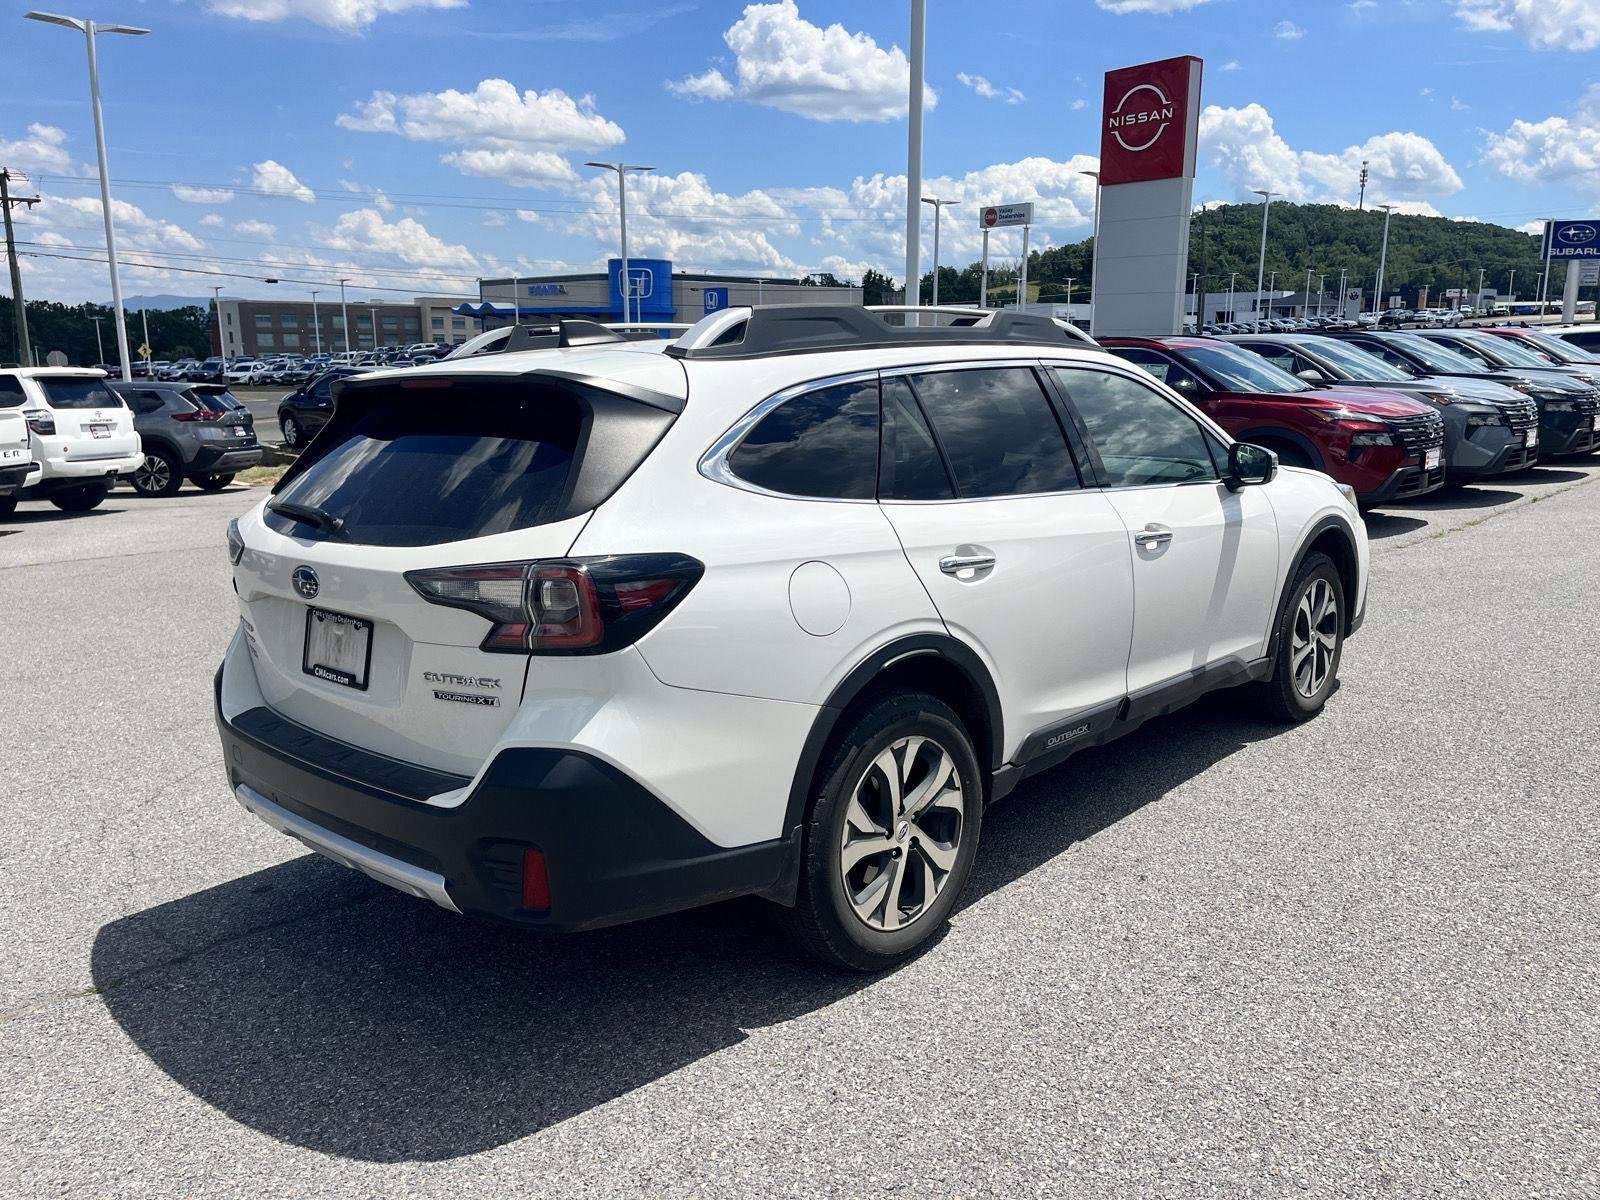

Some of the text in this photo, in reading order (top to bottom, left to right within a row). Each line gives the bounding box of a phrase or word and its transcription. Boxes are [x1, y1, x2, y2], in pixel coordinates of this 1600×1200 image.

[1109, 107, 1173, 128] NISSAN
[314, 667, 349, 685] CMAcars.com
[423, 671, 502, 688] OUTBACK
[438, 693, 477, 703] TOURING
[1047, 724, 1088, 746] OUTBACK
